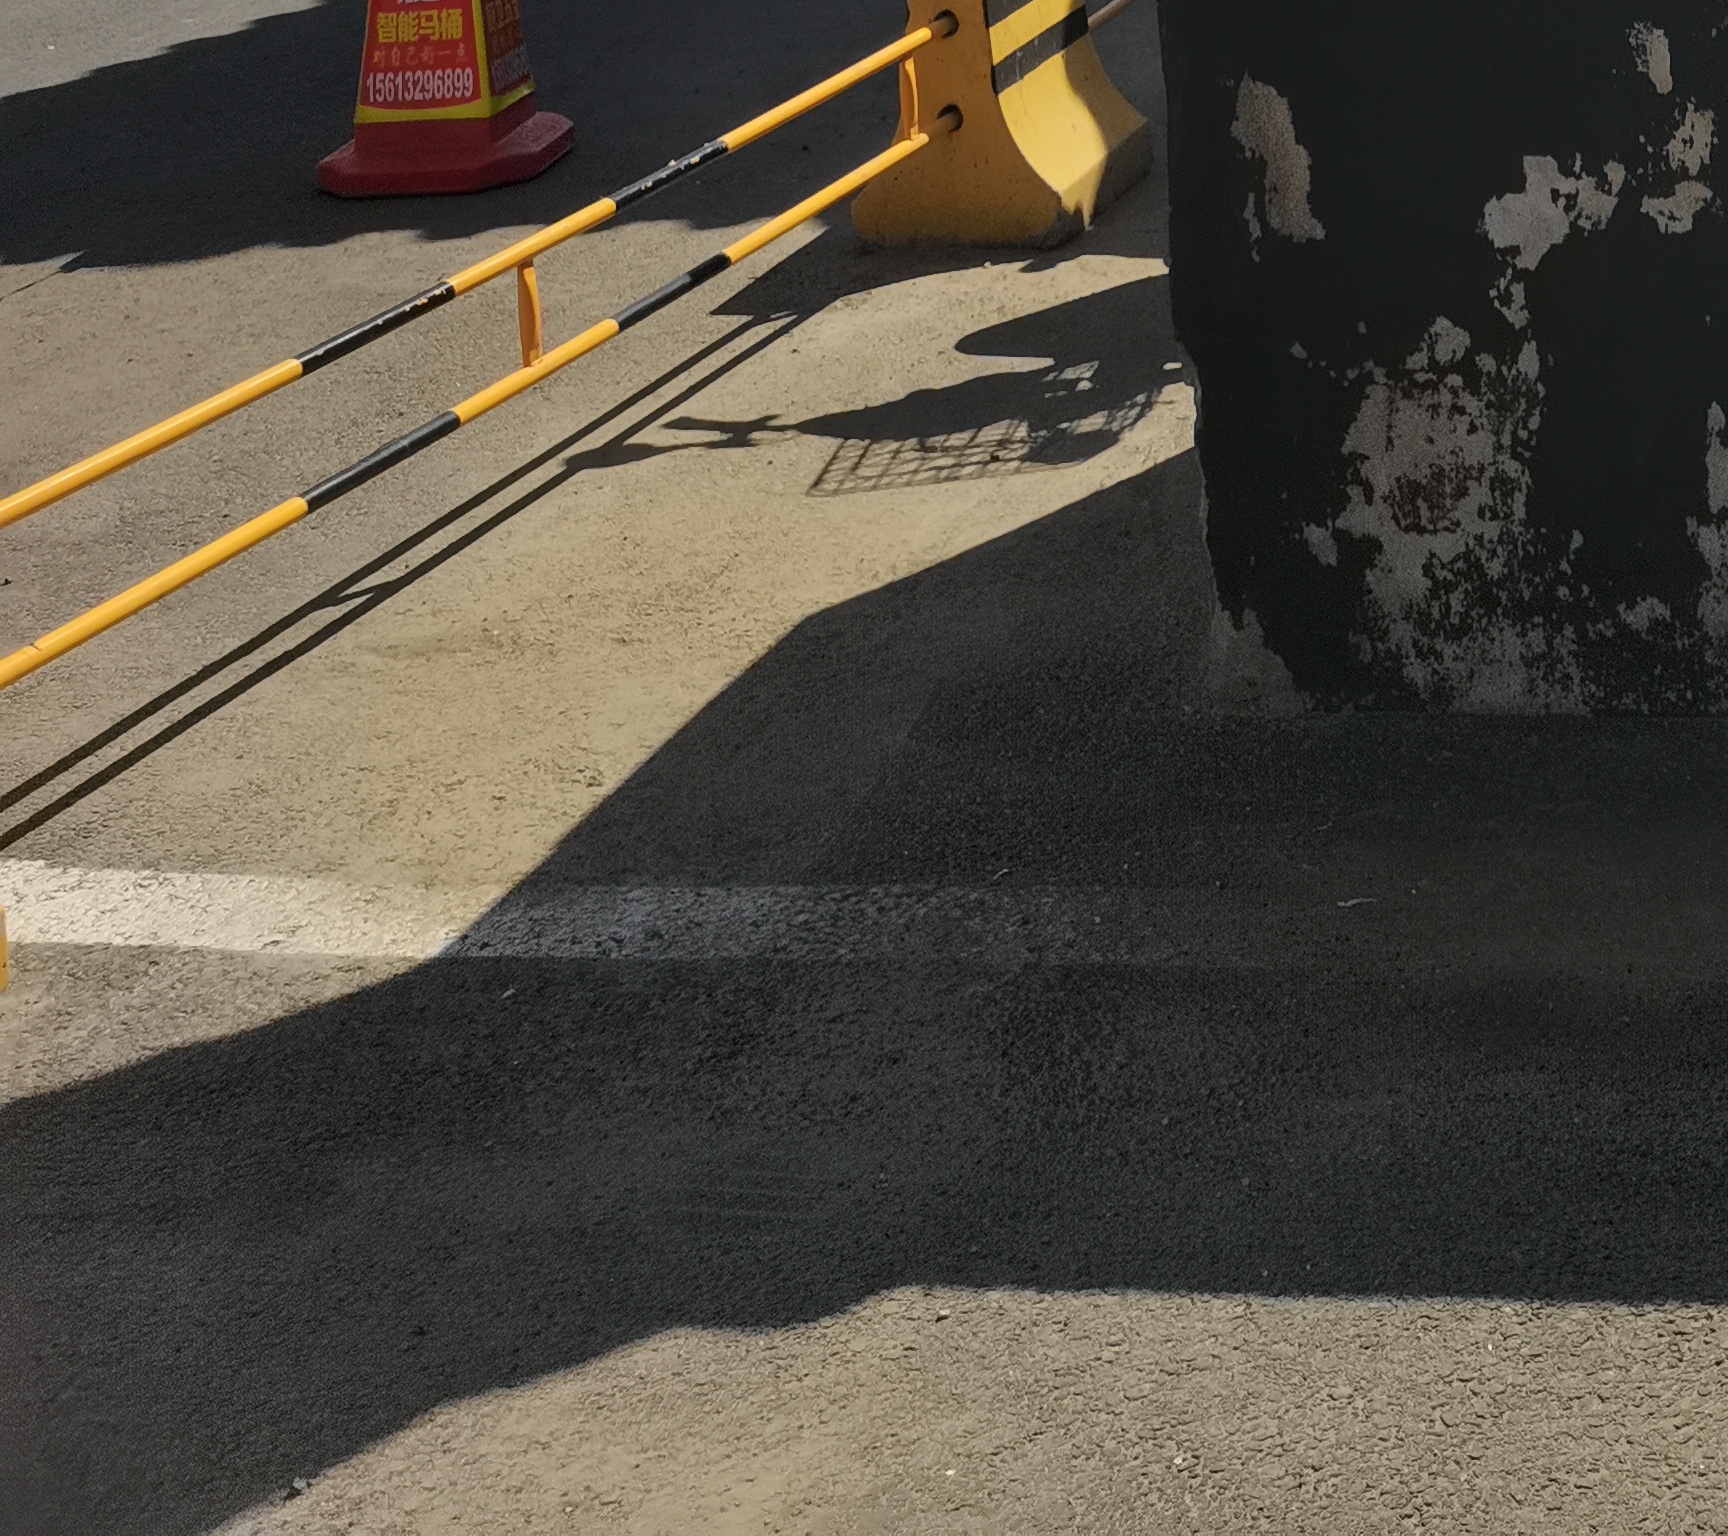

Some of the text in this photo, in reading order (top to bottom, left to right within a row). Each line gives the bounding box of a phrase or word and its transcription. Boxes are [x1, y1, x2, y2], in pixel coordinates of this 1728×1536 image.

[376, 7, 463, 44] 智能马桶
[366, 66, 473, 104] 15613296899
